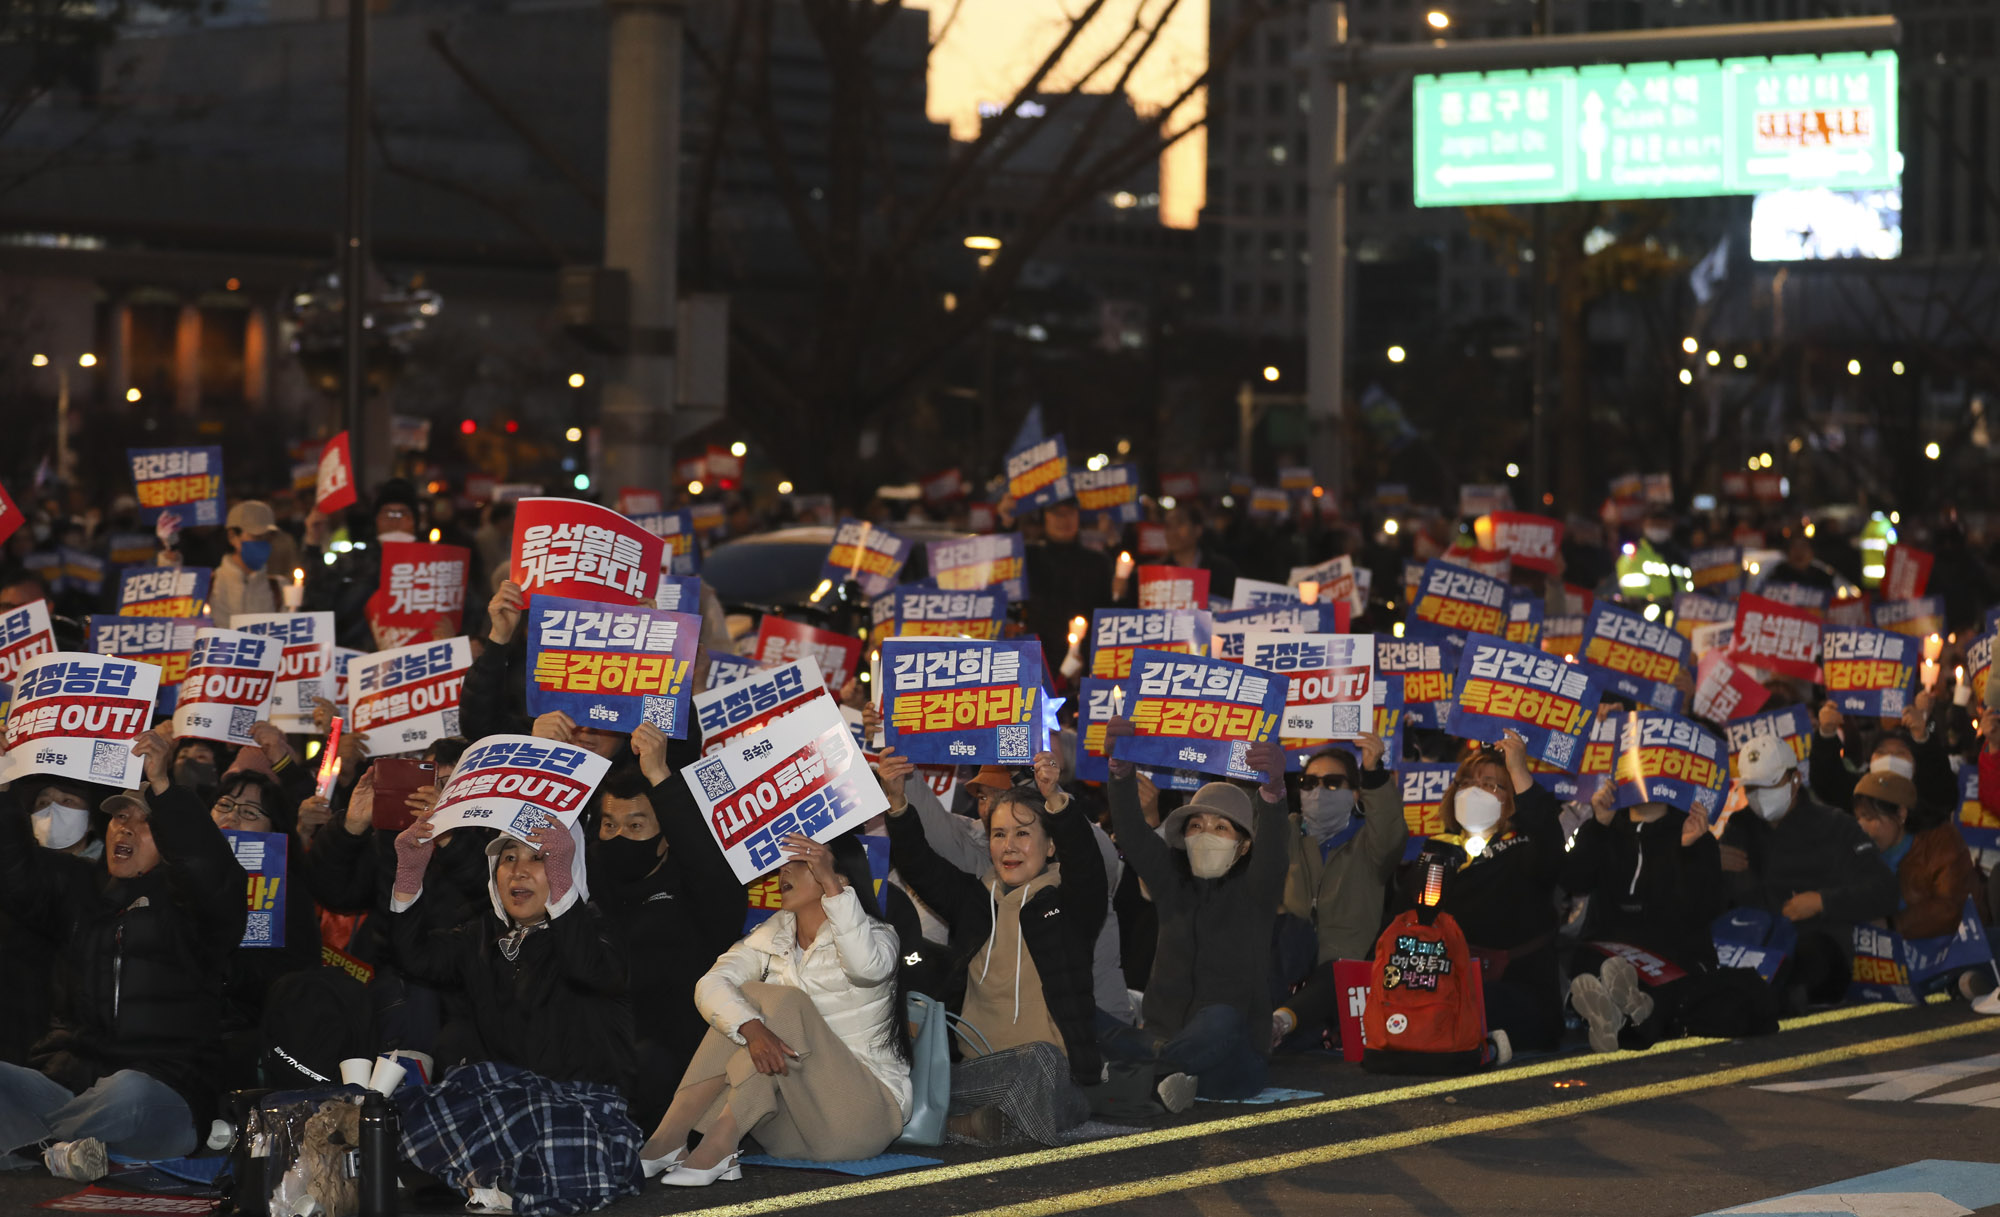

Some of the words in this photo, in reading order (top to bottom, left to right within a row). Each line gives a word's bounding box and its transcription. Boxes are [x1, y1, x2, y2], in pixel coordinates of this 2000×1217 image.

[132, 450, 208, 480] 김건희를
[522, 523, 643, 569] 윤석열을
[122, 570, 198, 603] 김건희를
[520, 552, 648, 599] 거부한다!
[1427, 569, 1505, 608] 김건희를
[901, 594, 995, 620] 김건희를
[97, 621, 195, 654] 김건희를
[540, 609, 679, 652] 김건희를
[1097, 611, 1195, 647] 김건희를
[1595, 611, 1682, 658] 김건희를
[1823, 631, 1904, 660] 김건희를
[360, 642, 453, 691] 국정농단
[894, 647, 1020, 690] 김건희를
[1255, 638, 1355, 670] 국정농단
[1377, 642, 1441, 670] 김건희를
[17, 662, 138, 700] 국정농단
[205, 674, 268, 701] OUT!
[533, 652, 689, 695] 특검하라!
[1139, 662, 1269, 704] 김건희를
[1302, 673, 1366, 700] OUT!
[1403, 673, 1453, 702] 하라!
[1470, 646, 1589, 700] 김건희를
[354, 693, 411, 726] 윤석열
[589, 707, 619, 721] 민주당
[699, 665, 805, 732] 국정농단
[891, 687, 1038, 731] 특검하라!
[1459, 679, 1592, 736] 특검하라!
[5, 705, 61, 744] 윤석열
[60, 704, 143, 734] OUT!
[402, 729, 428, 743] 민주당
[1129, 700, 1278, 742] 특검하라!
[1287, 718, 1314, 729] 민주당
[741, 739, 773, 763] 민주당
[949, 745, 976, 756] 민주당
[1620, 717, 1716, 760] 김건희를
[35, 752, 68, 766] 민주당
[458, 743, 587, 777] 국정농단
[1178, 749, 1207, 764] 민주당
[496, 774, 581, 808] OUT!
[462, 808, 493, 819] 민주당
[716, 781, 779, 840] OUT!
[1391, 955, 1450, 973] 해양투기
[1402, 970, 1436, 988] 반대
